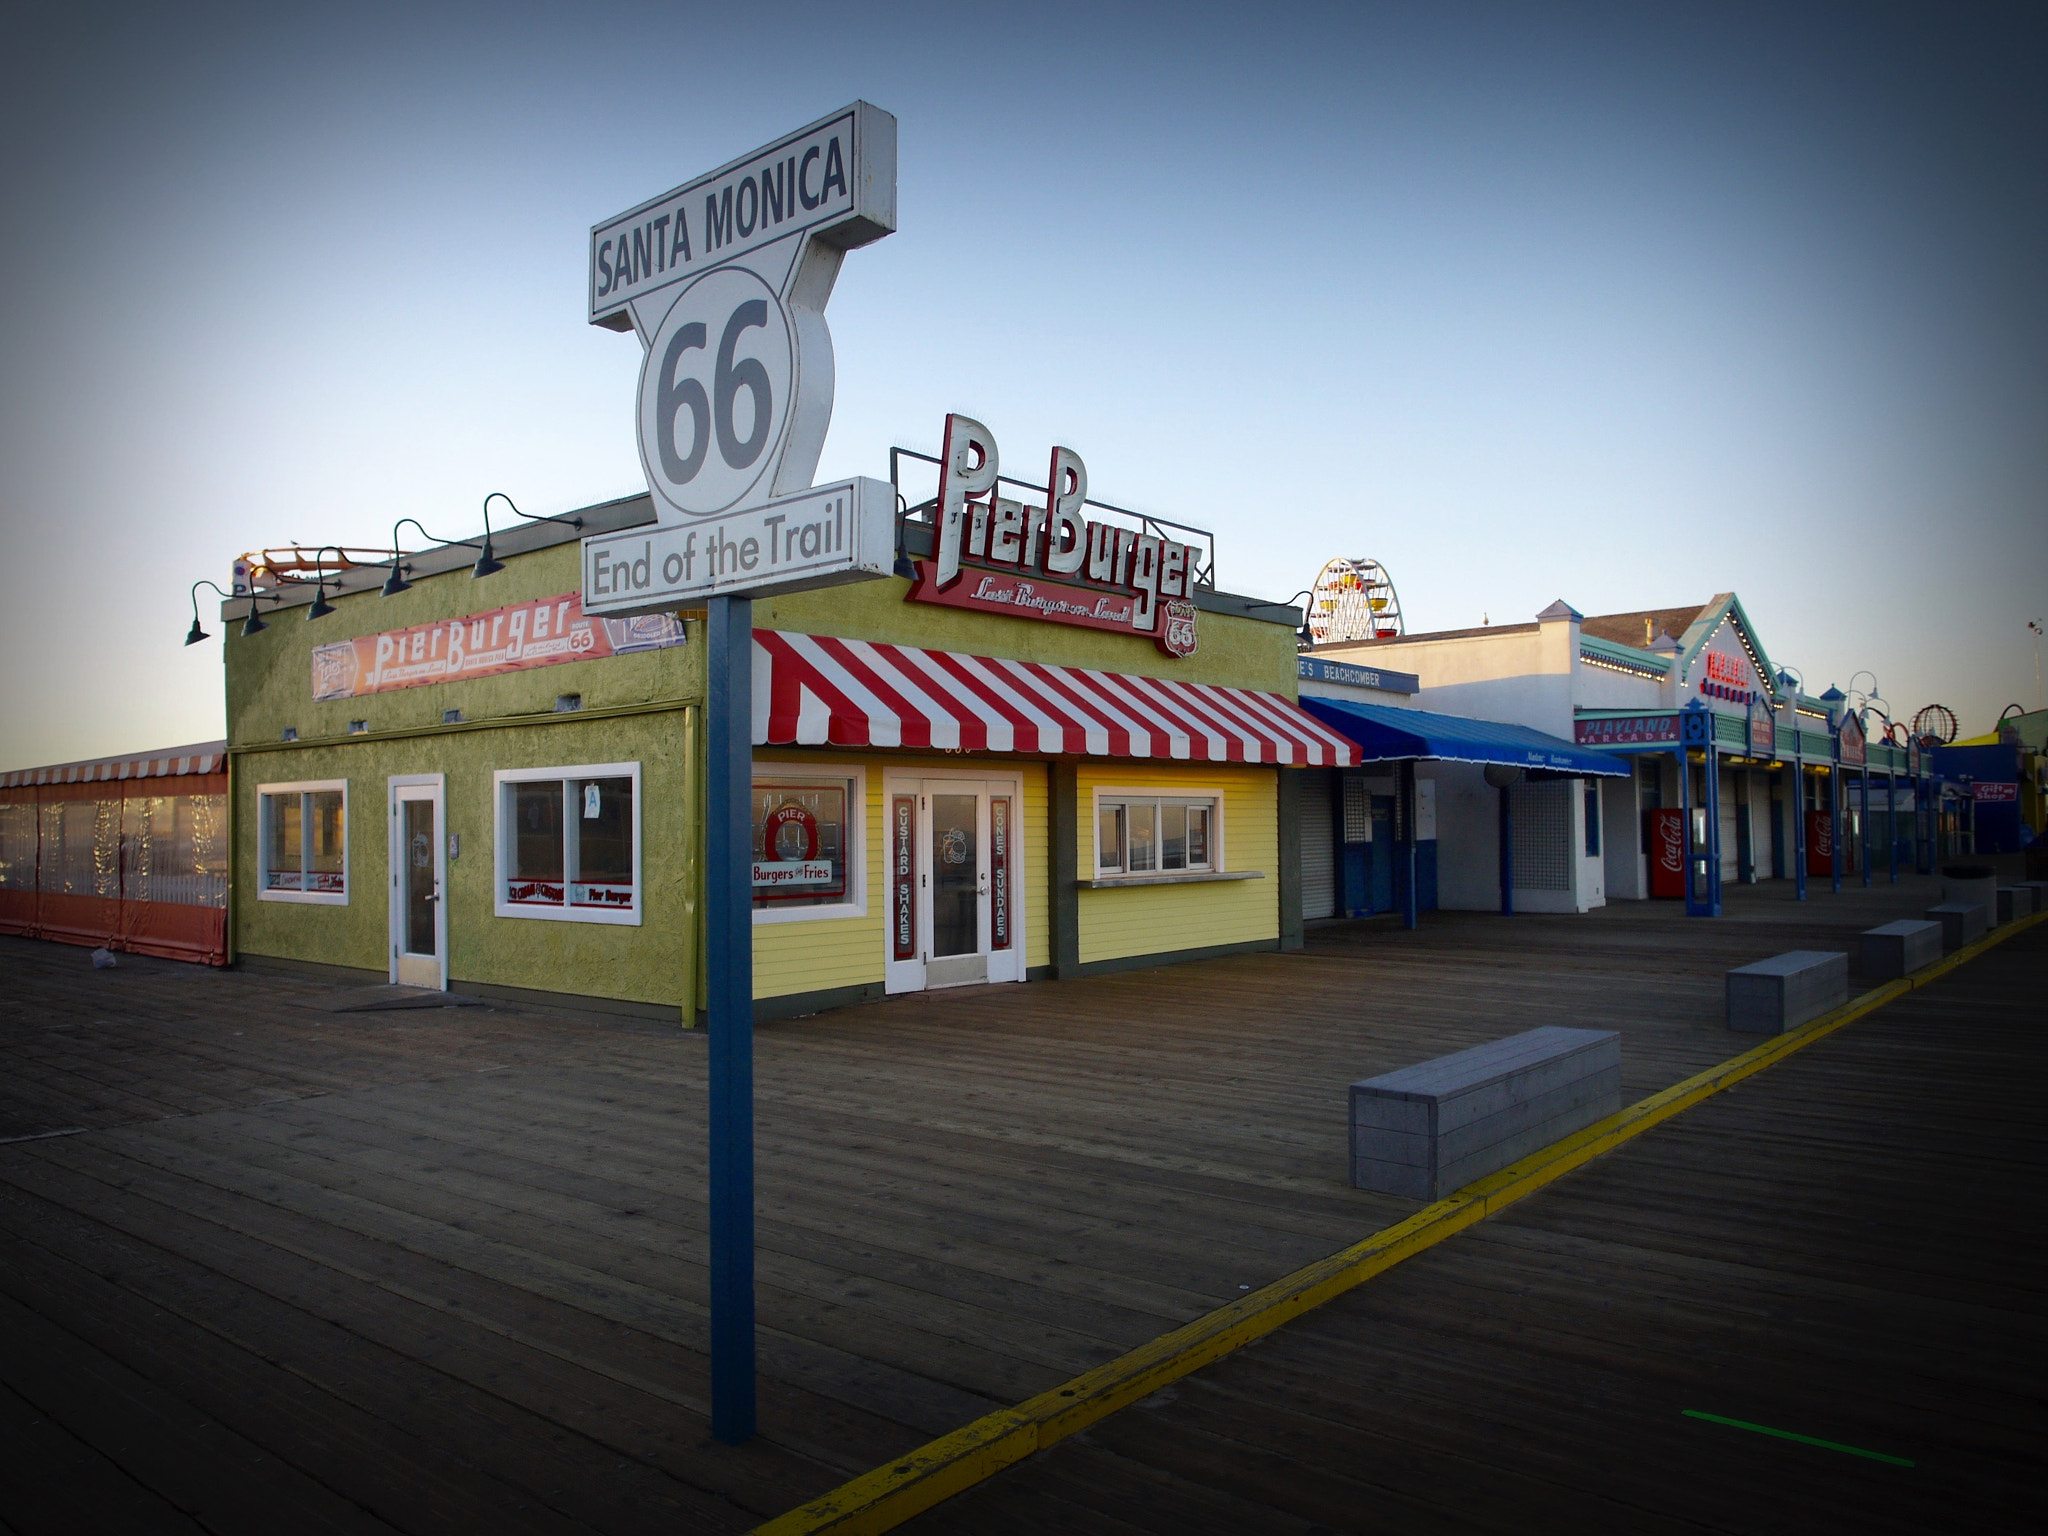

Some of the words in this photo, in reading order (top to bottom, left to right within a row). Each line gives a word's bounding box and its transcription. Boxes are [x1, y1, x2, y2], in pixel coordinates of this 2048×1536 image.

[598, 207, 692, 298] SANTA
[705, 136, 847, 254] MONICA
[656, 299, 773, 486] 66
[593, 541, 652, 594] End
[663, 532, 698, 584] of
[706, 525, 759, 578] the
[765, 498, 843, 567] Trail
[571, 621, 590, 632] ROUTE
[1170, 621, 1195, 647] 66
[570, 631, 591, 649] 66
[1323, 664, 1381, 687] BEACHCOMBER
[1584, 718, 1672, 735] PLAYLAND
[1587, 731, 1667, 744] ARCADE
[588, 791, 597, 807] A
[1976, 792, 2006, 801] Shop
[1980, 784, 2003, 793] Gift
[777, 808, 806, 822] PIER
[898, 806, 910, 876] CUSTARD
[995, 807, 1005, 856] CONES
[753, 865, 793, 883] Burgers
[804, 864, 829, 879] Fries
[996, 868, 1005, 937] SUNDAES
[899, 883, 910, 945] SHAKES
